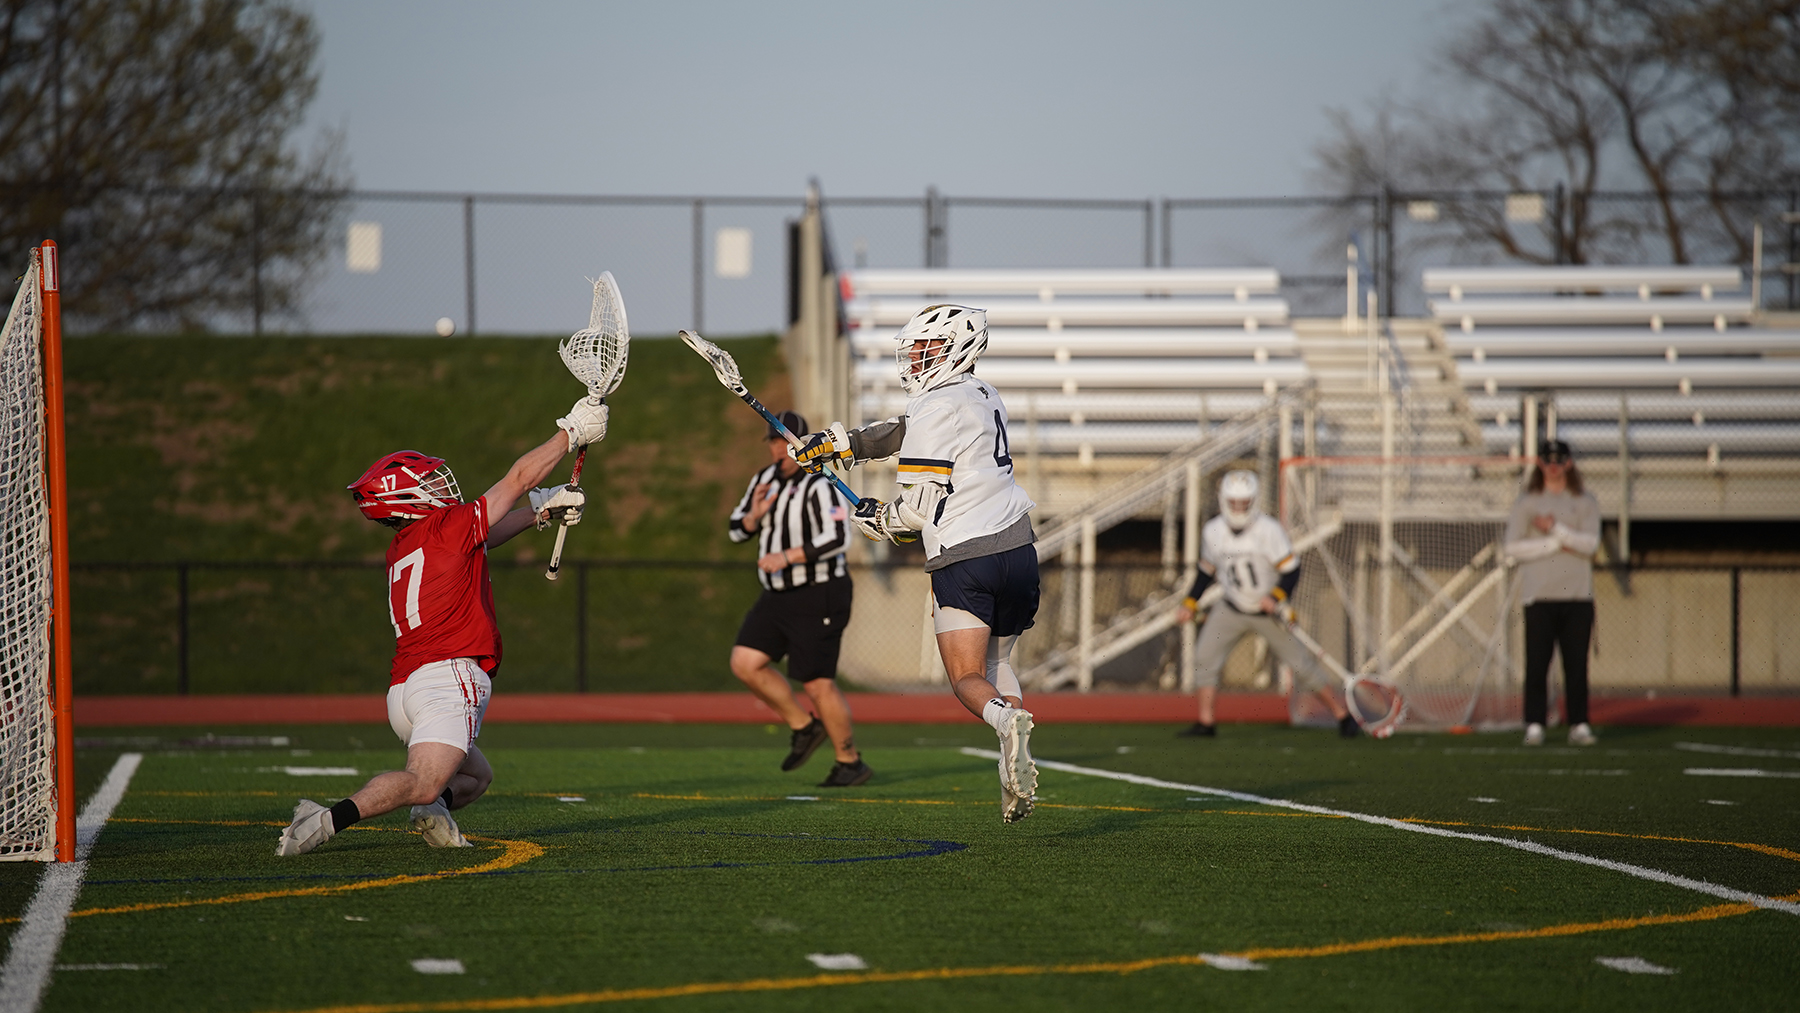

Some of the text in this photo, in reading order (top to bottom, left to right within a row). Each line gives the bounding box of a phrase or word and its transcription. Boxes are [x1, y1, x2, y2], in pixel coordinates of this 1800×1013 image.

[966, 319, 975, 332] 4
[993, 409, 1014, 475] 4
[381, 474, 397, 492] 17
[388, 547, 425, 638] 17
